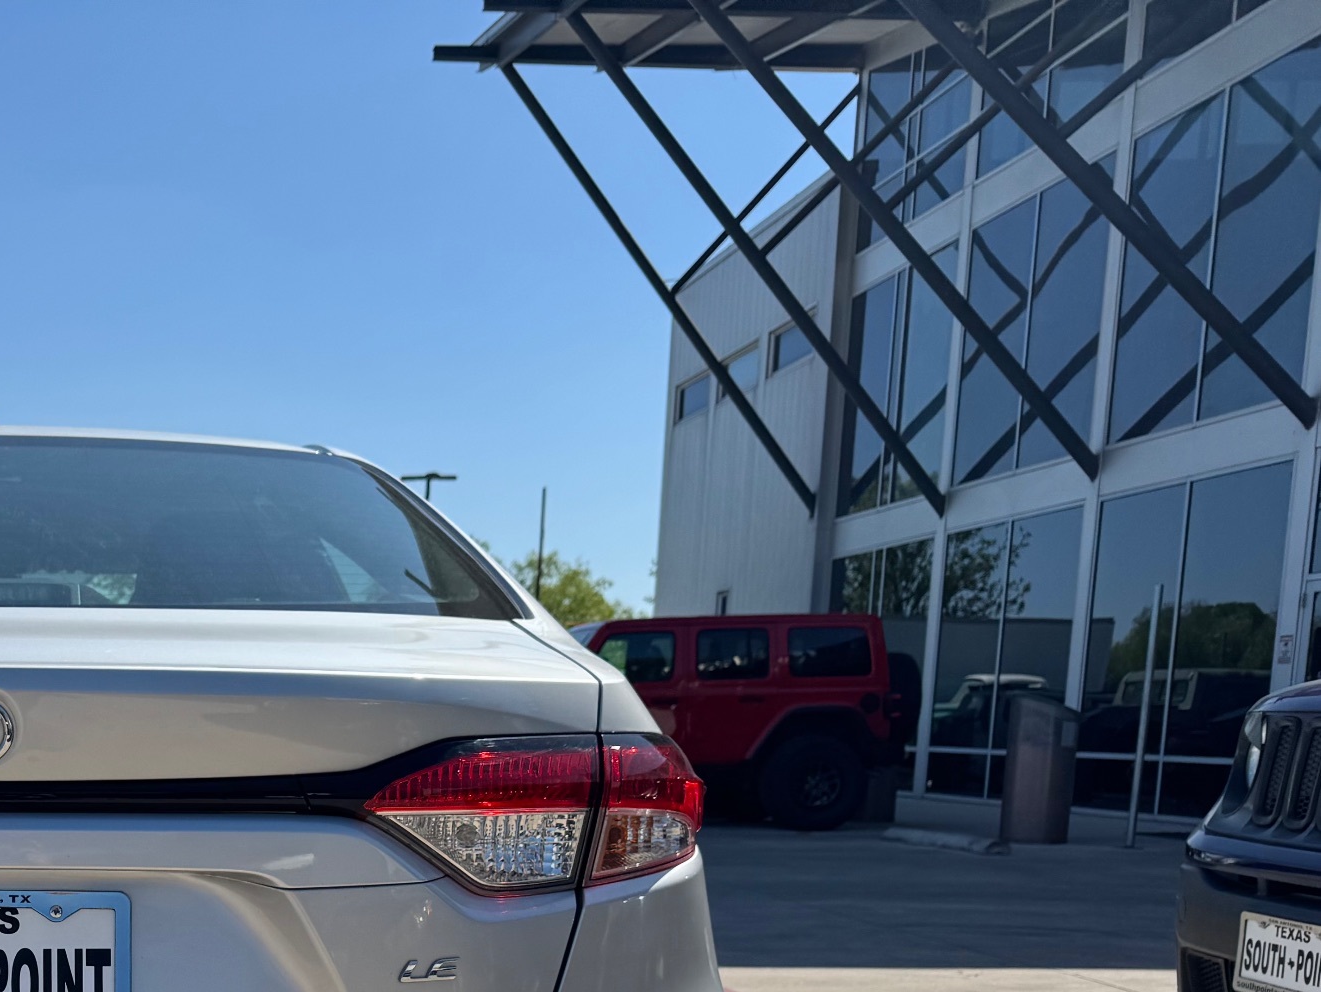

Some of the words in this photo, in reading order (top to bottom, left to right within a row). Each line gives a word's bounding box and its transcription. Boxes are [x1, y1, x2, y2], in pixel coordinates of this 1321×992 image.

[9, 894, 32, 904] TX
[1275, 925, 1312, 943] TEXAS
[397, 956, 461, 983] LE
[1244, 938, 1287, 979] SOUTH
